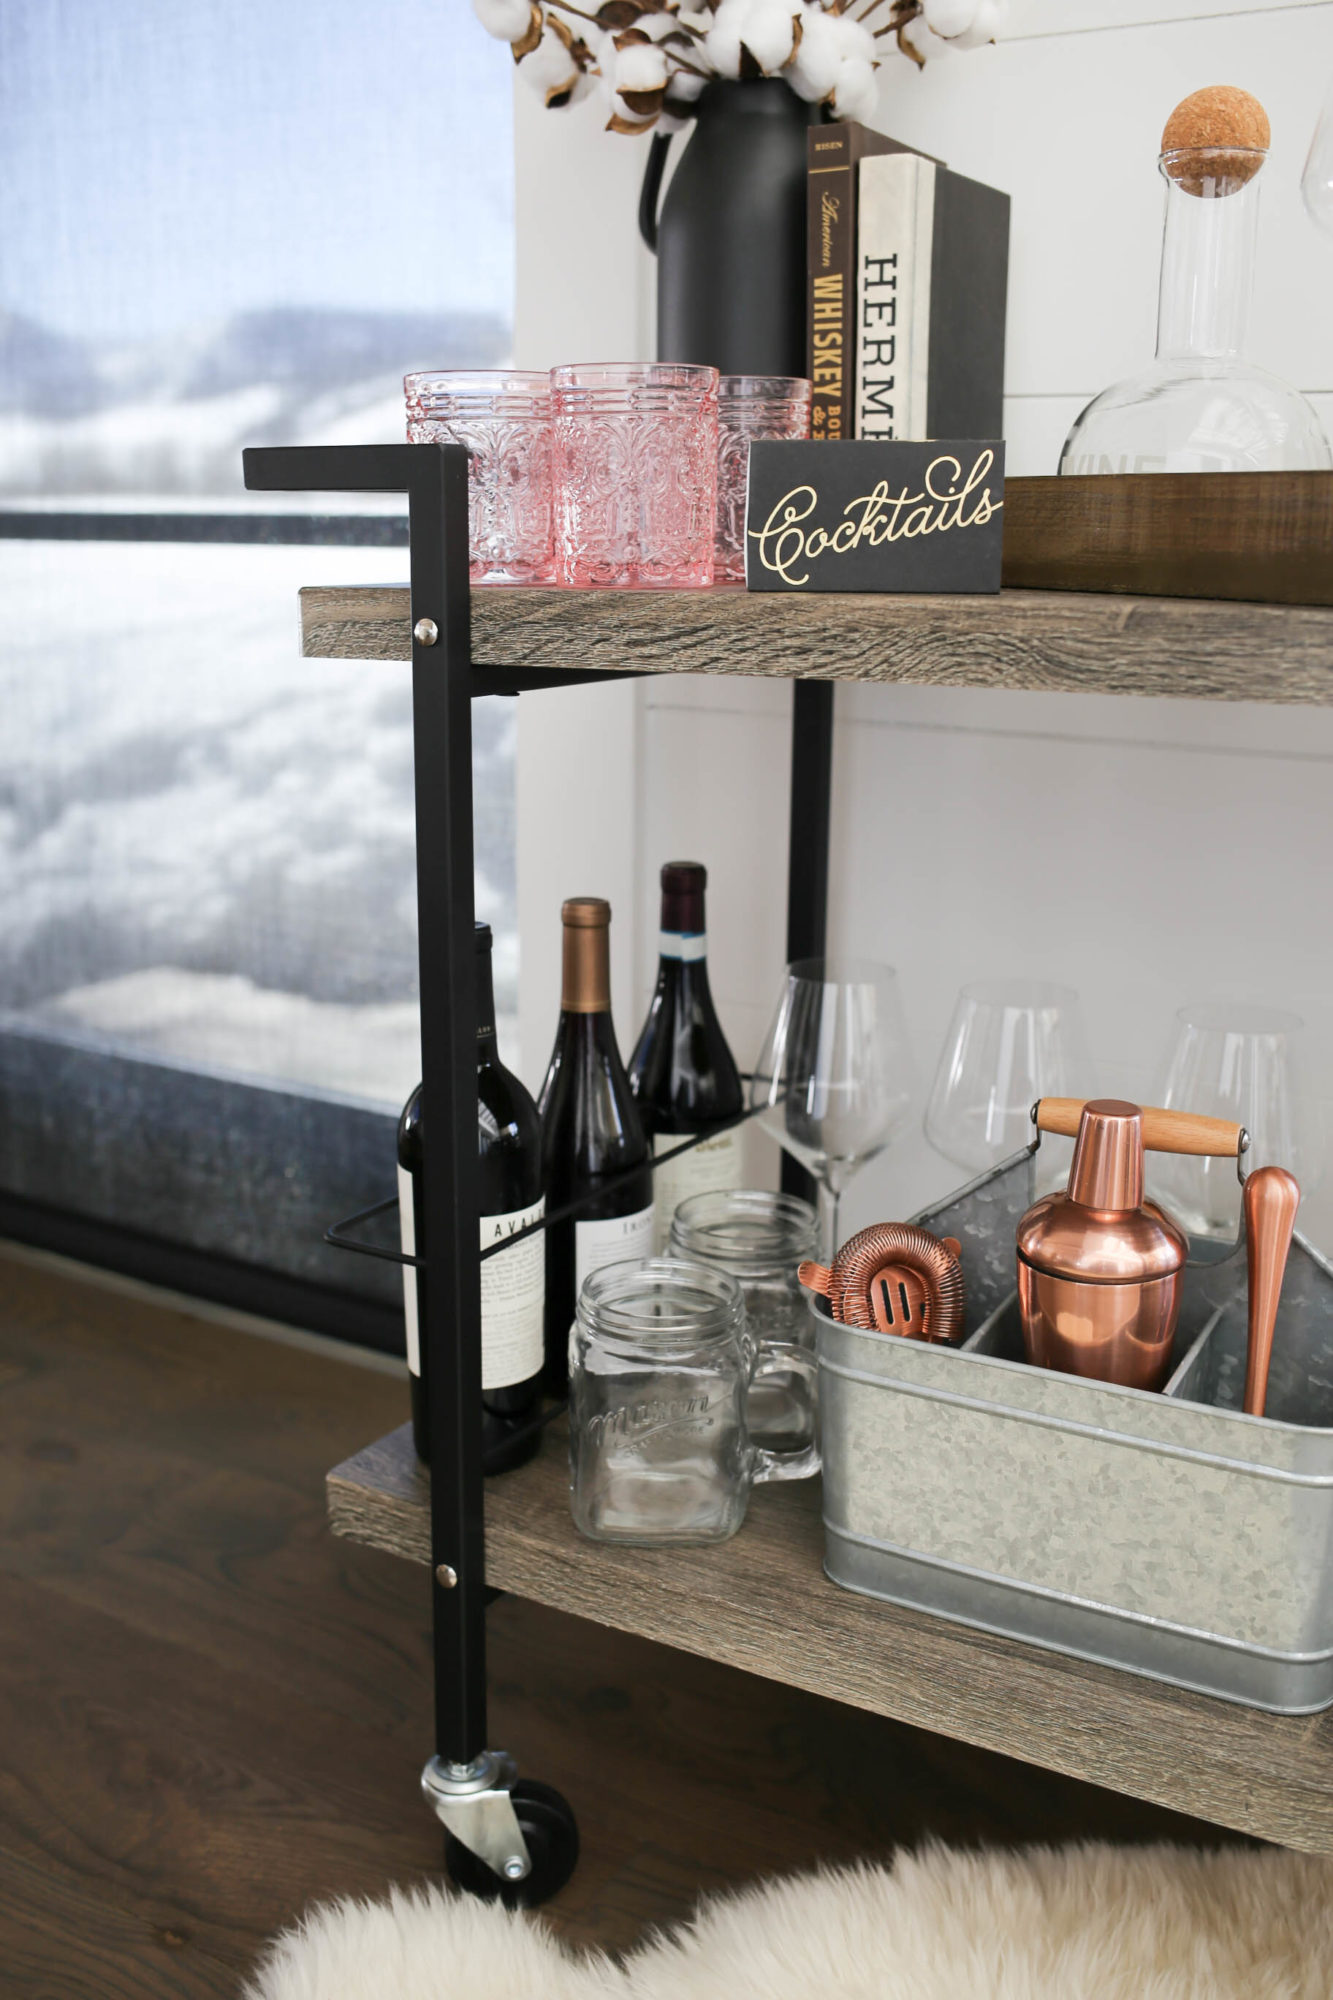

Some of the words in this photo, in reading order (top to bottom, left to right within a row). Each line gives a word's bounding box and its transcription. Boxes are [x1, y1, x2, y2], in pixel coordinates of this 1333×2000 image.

[822, 191, 840, 267] American
[813, 273, 843, 397] WHISKEY
[748, 449, 1004, 586] Cocktails
